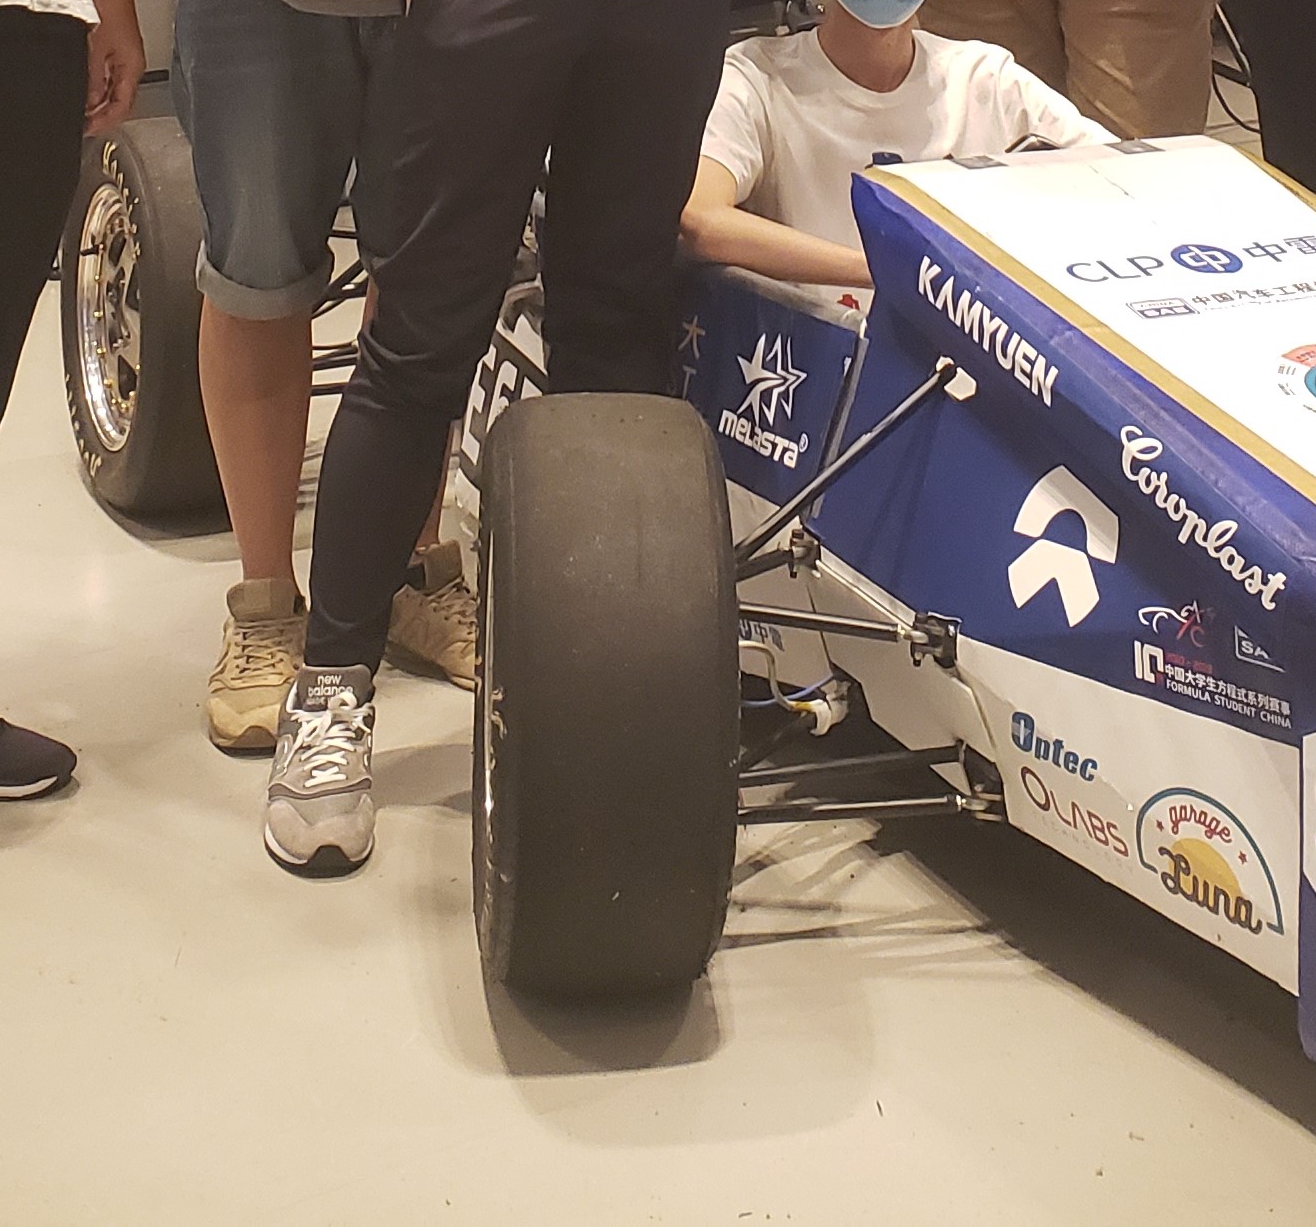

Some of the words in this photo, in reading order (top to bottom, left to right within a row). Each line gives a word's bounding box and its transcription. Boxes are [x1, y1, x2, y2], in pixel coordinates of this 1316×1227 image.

[1066, 255, 1164, 282] CLP
[917, 255, 1060, 408] KAMYUEN
[1120, 425, 1287, 610] Coroplast
[308, 685, 354, 696] balance
[317, 674, 342, 685] new
[1166, 679, 1212, 704] FORMULA
[1214, 694, 1257, 718] STUDENT
[1260, 710, 1292, 729] CHINA
[1168, 804, 1233, 844] garage
[1158, 845, 1263, 936] Luna
